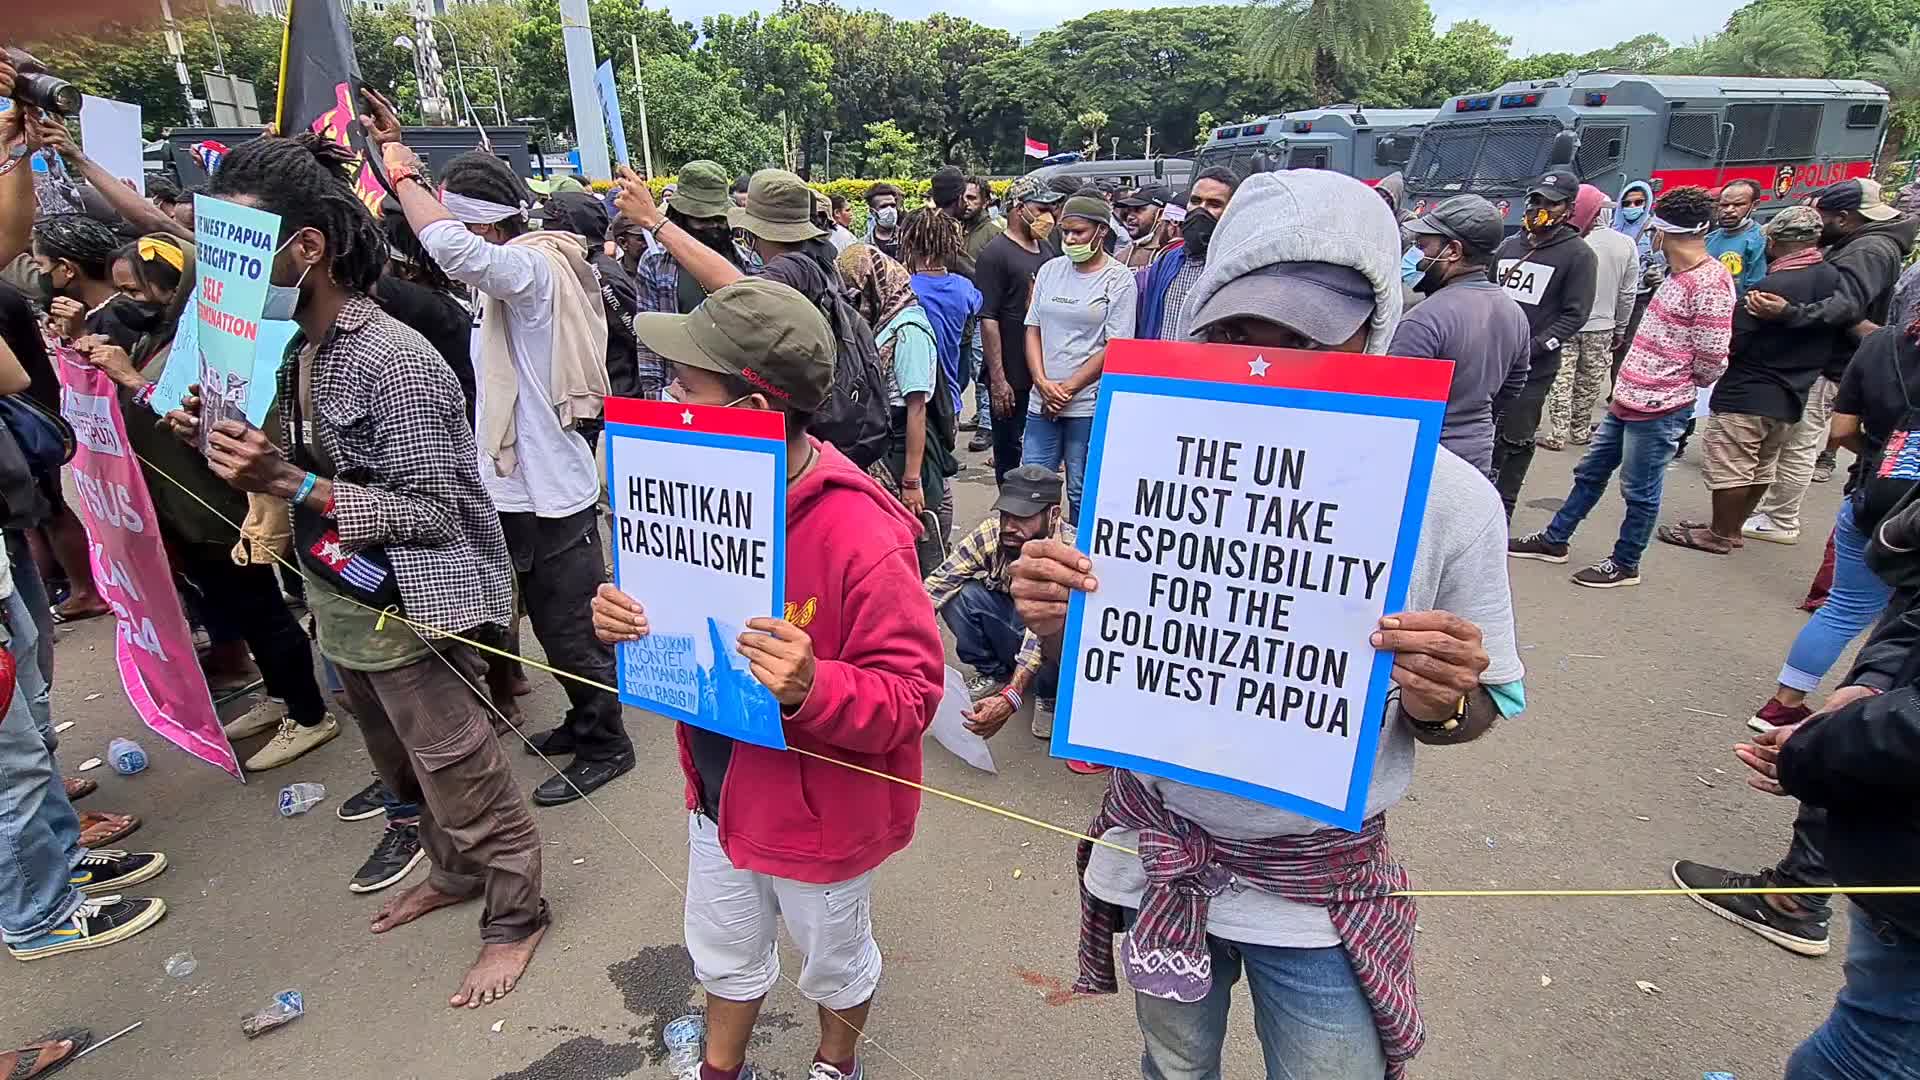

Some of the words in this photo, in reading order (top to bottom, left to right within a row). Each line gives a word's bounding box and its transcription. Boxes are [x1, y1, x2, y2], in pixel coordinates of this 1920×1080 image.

[1794, 161, 1848, 188] POLISI
[203, 216, 226, 240] WEST
[227, 223, 272, 252] PAPUA
[203, 245, 237, 273] RIGHT
[239, 254, 262, 280] TO
[203, 275, 225, 305] SELF
[1177, 435, 1242, 483] THE
[1254, 445, 1307, 490] UN
[628, 475, 752, 530] HENTIKAN
[1135, 478, 1233, 532] MUST
[1246, 492, 1339, 545] TAKE
[620, 516, 766, 579] RASIALISME
[1095, 518, 1388, 601] RESPONSIBILITY
[1149, 572, 1212, 618] FOR
[1226, 586, 1295, 632] THE
[1101, 607, 1349, 689] COLONIZATION
[1085, 648, 1124, 685] OF
[1136, 655, 1226, 706] WEST
[1237, 677, 1349, 738] PAPUA
